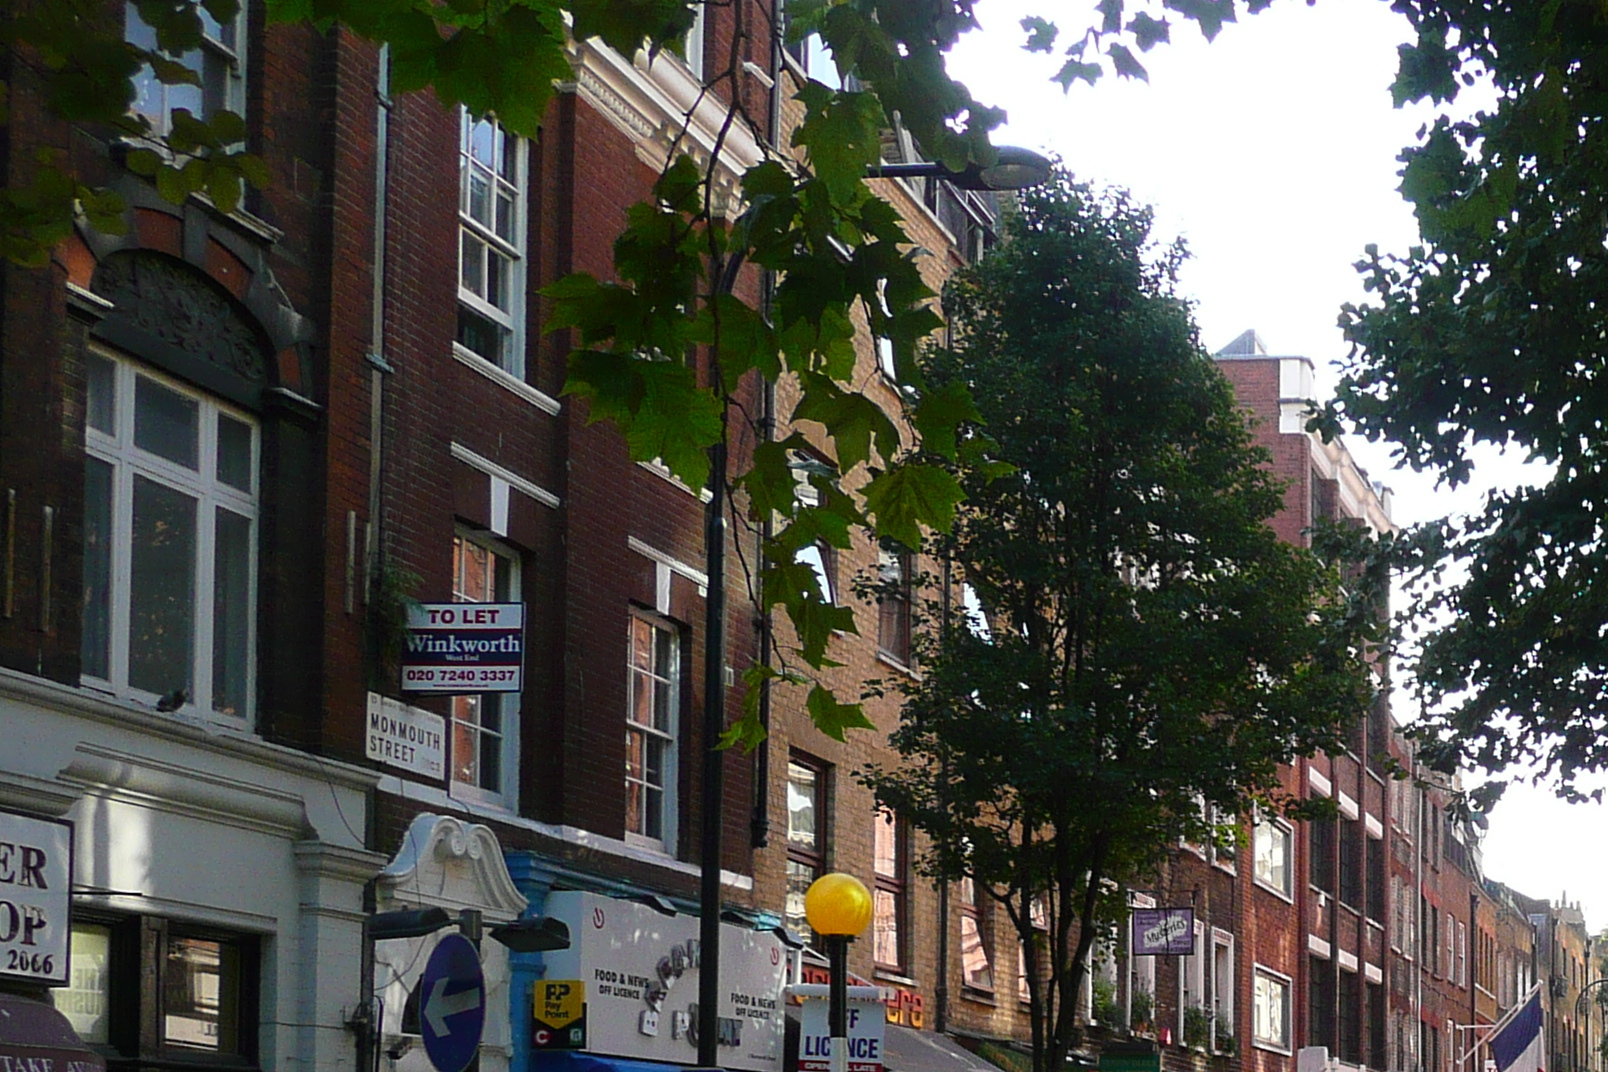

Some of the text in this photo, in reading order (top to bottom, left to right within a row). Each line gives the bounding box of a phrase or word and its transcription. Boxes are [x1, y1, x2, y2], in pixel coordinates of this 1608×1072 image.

[428, 609, 499, 624] TO LET
[407, 634, 520, 653] Winkworth
[407, 670, 515, 681] 020 7240 3337
[371, 712, 440, 751] MONMOUTH
[370, 735, 415, 764] STREET
[7, 949, 54, 974] 2066
[594, 968, 649, 988] FOOD & NEWS
[599, 984, 640, 999] OFF LICENCE
[545, 1001, 562, 1012] Pay
[731, 992, 776, 1009] FOOD & NEWS
[544, 1010, 569, 1019] Point
[735, 1006, 746, 1016] OFF
[804, 1036, 879, 1059] LICNCE
[804, 1062, 830, 1070] OPEN
[853, 1064, 876, 1072] LATE
